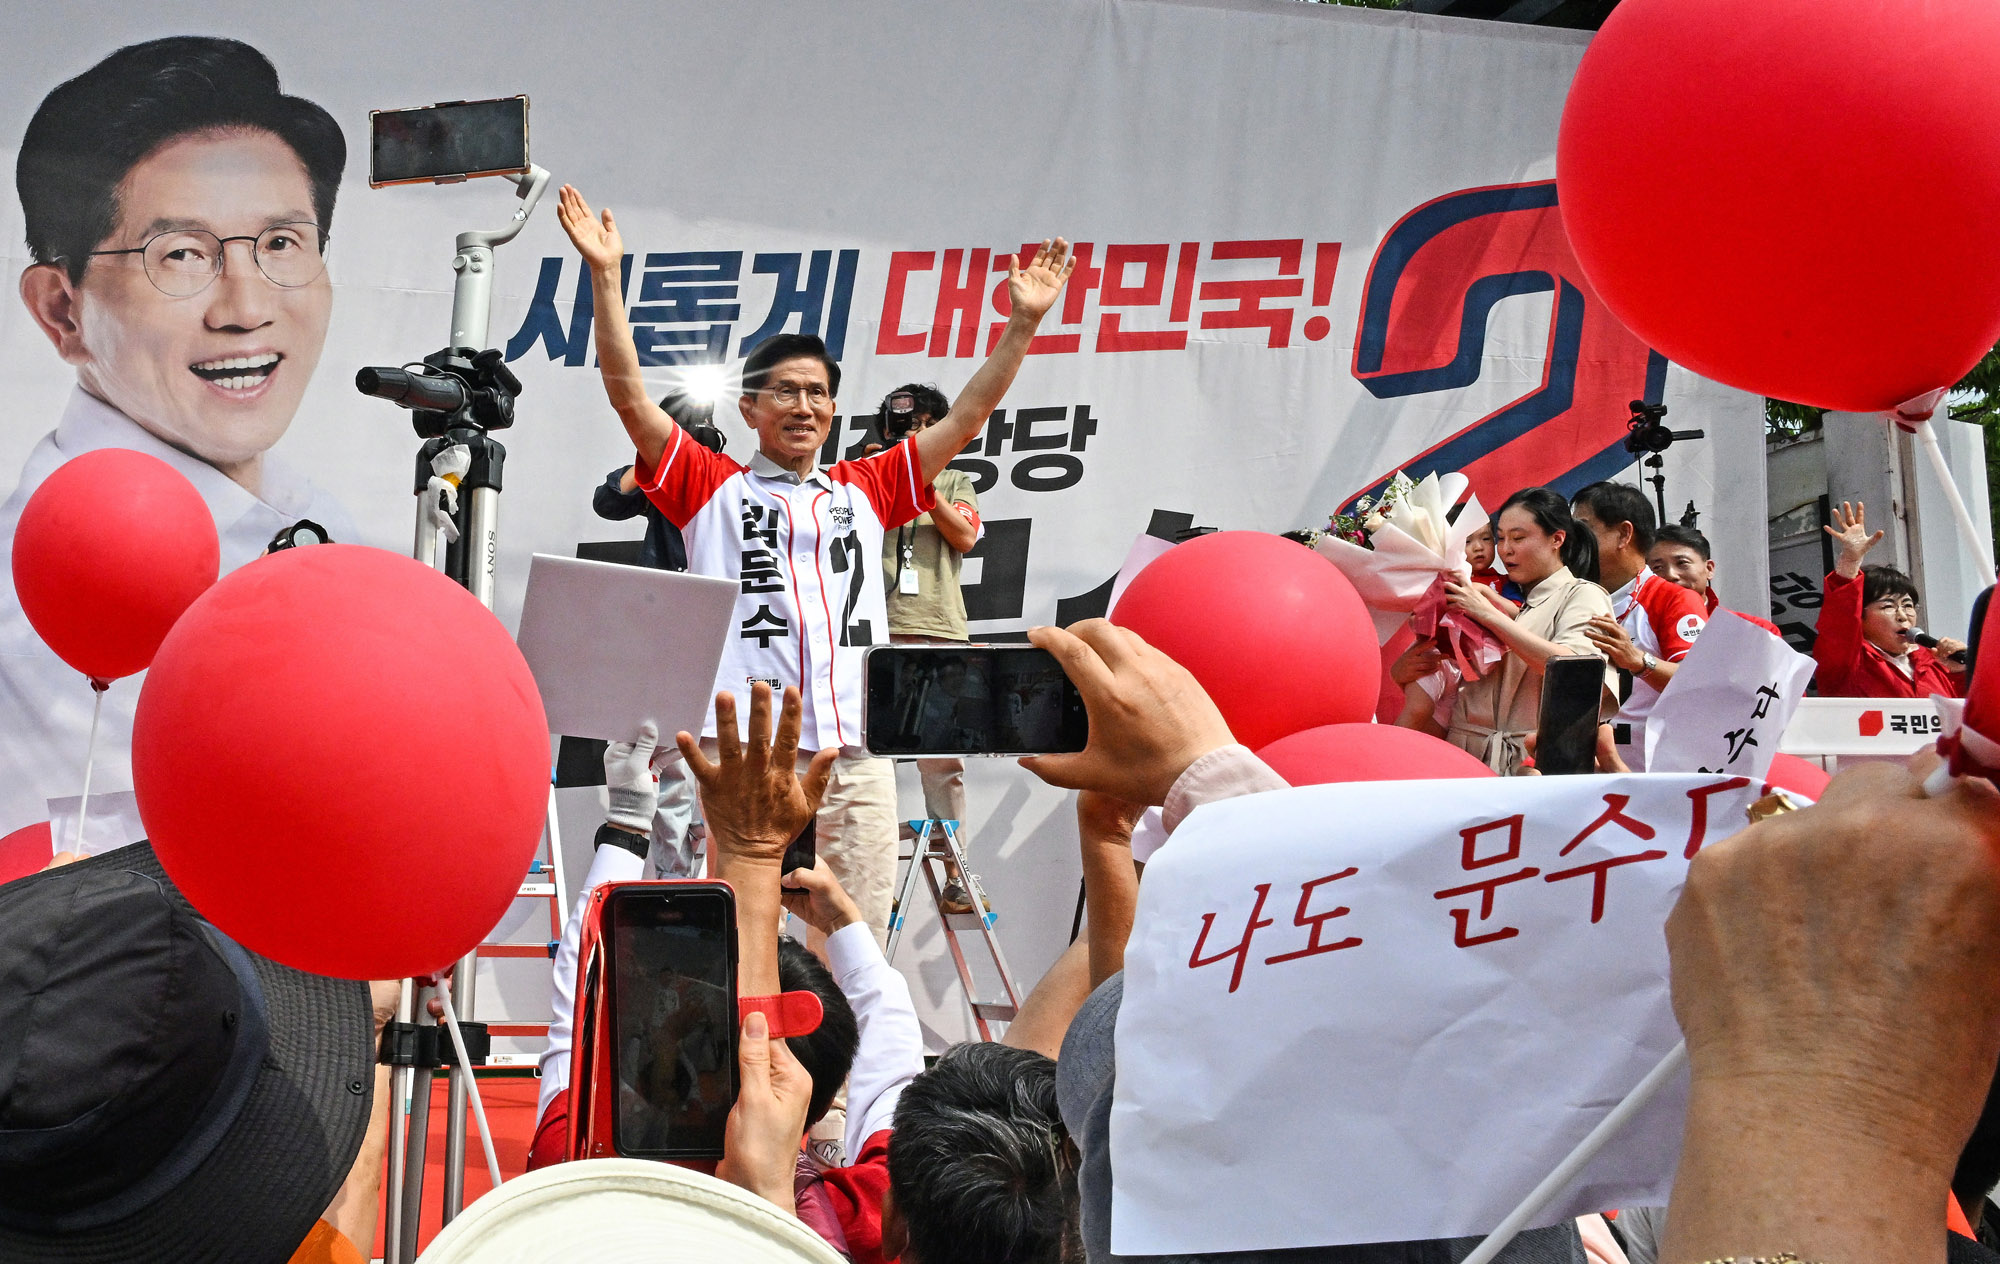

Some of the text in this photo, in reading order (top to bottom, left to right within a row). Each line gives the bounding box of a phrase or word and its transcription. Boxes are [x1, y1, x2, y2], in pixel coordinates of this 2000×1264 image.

[504, 238, 1342, 368] 새롭게 대한민국!
[1334, 178, 1671, 600] 2
[487, 530, 496, 580] SONY
[833, 515, 853, 525] POWE
[740, 498, 789, 649] 김문수
[829, 530, 873, 647] 2
[1683, 628, 1701, 637] 국민의
[1698, 682, 1780, 773] 수다
[1890, 714, 1942, 734] 국민의
[1188, 867, 1363, 993] 나도
